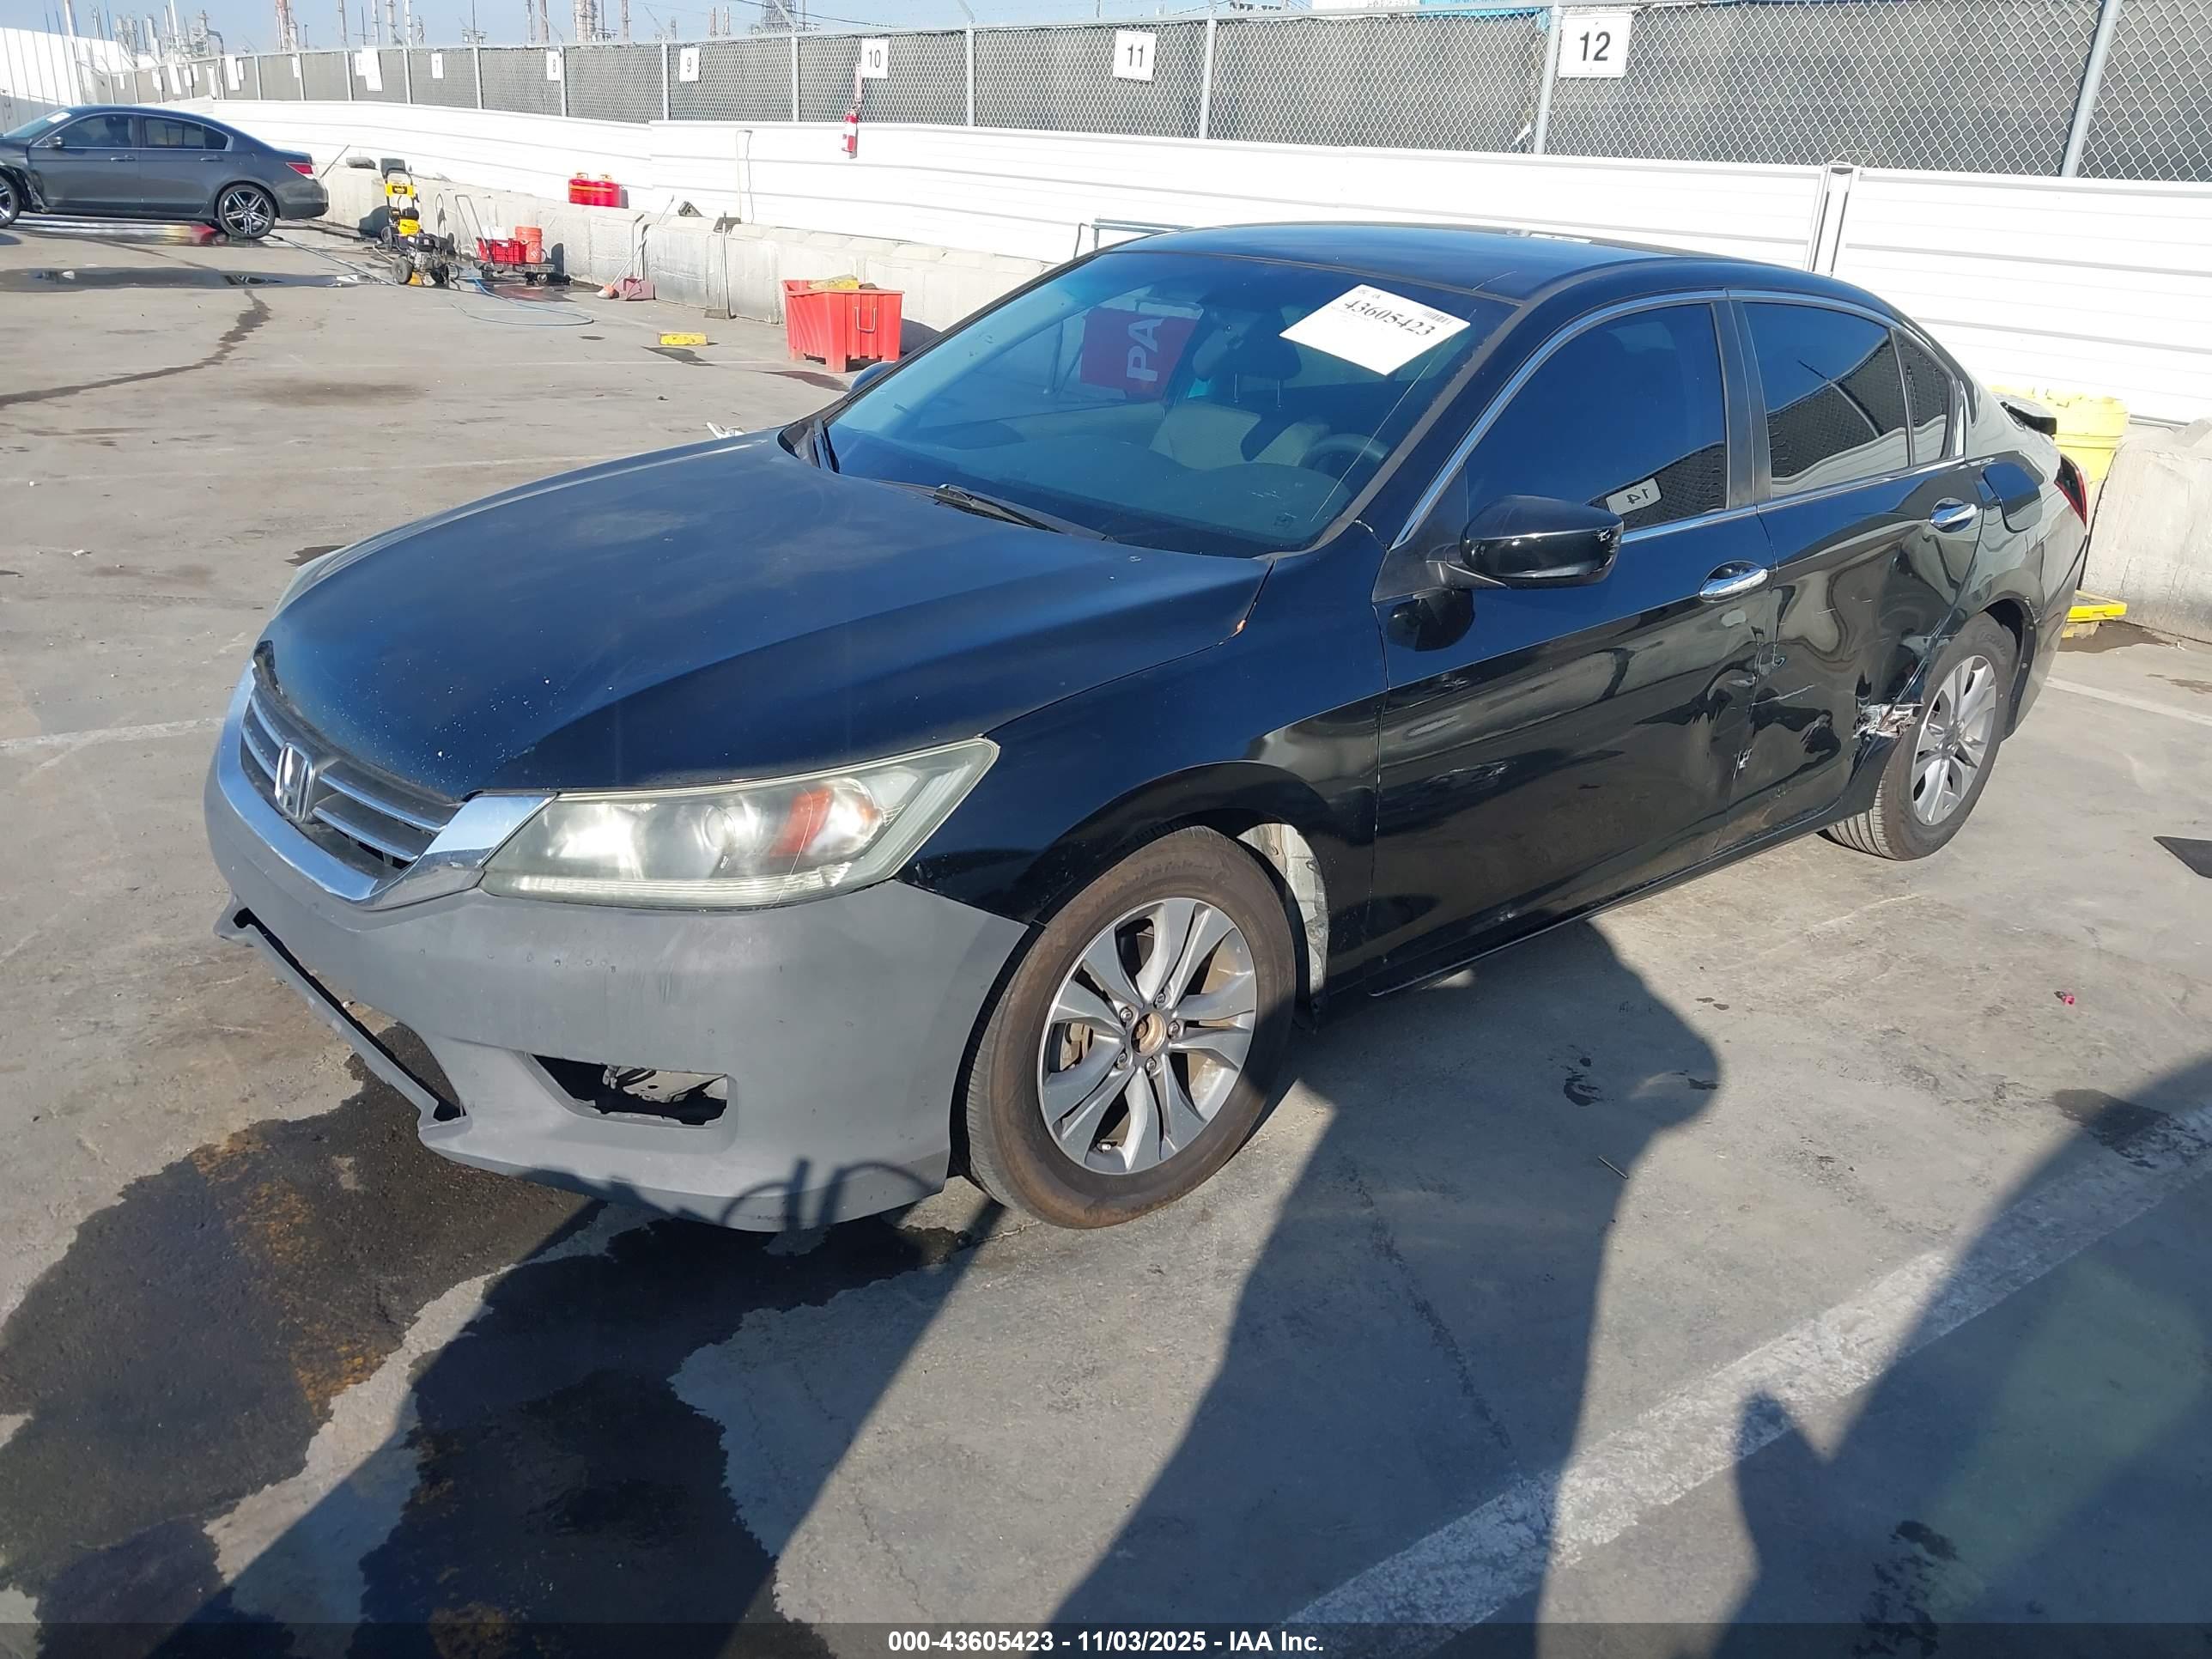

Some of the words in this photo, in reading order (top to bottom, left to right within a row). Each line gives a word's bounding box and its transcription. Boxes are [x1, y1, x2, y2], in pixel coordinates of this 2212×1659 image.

[1127, 44, 1144, 68] 11
[1579, 31, 1611, 62] 12
[687, 57, 692, 73] 9
[868, 49, 881, 69] 10
[1345, 300, 1436, 336] 43605423
